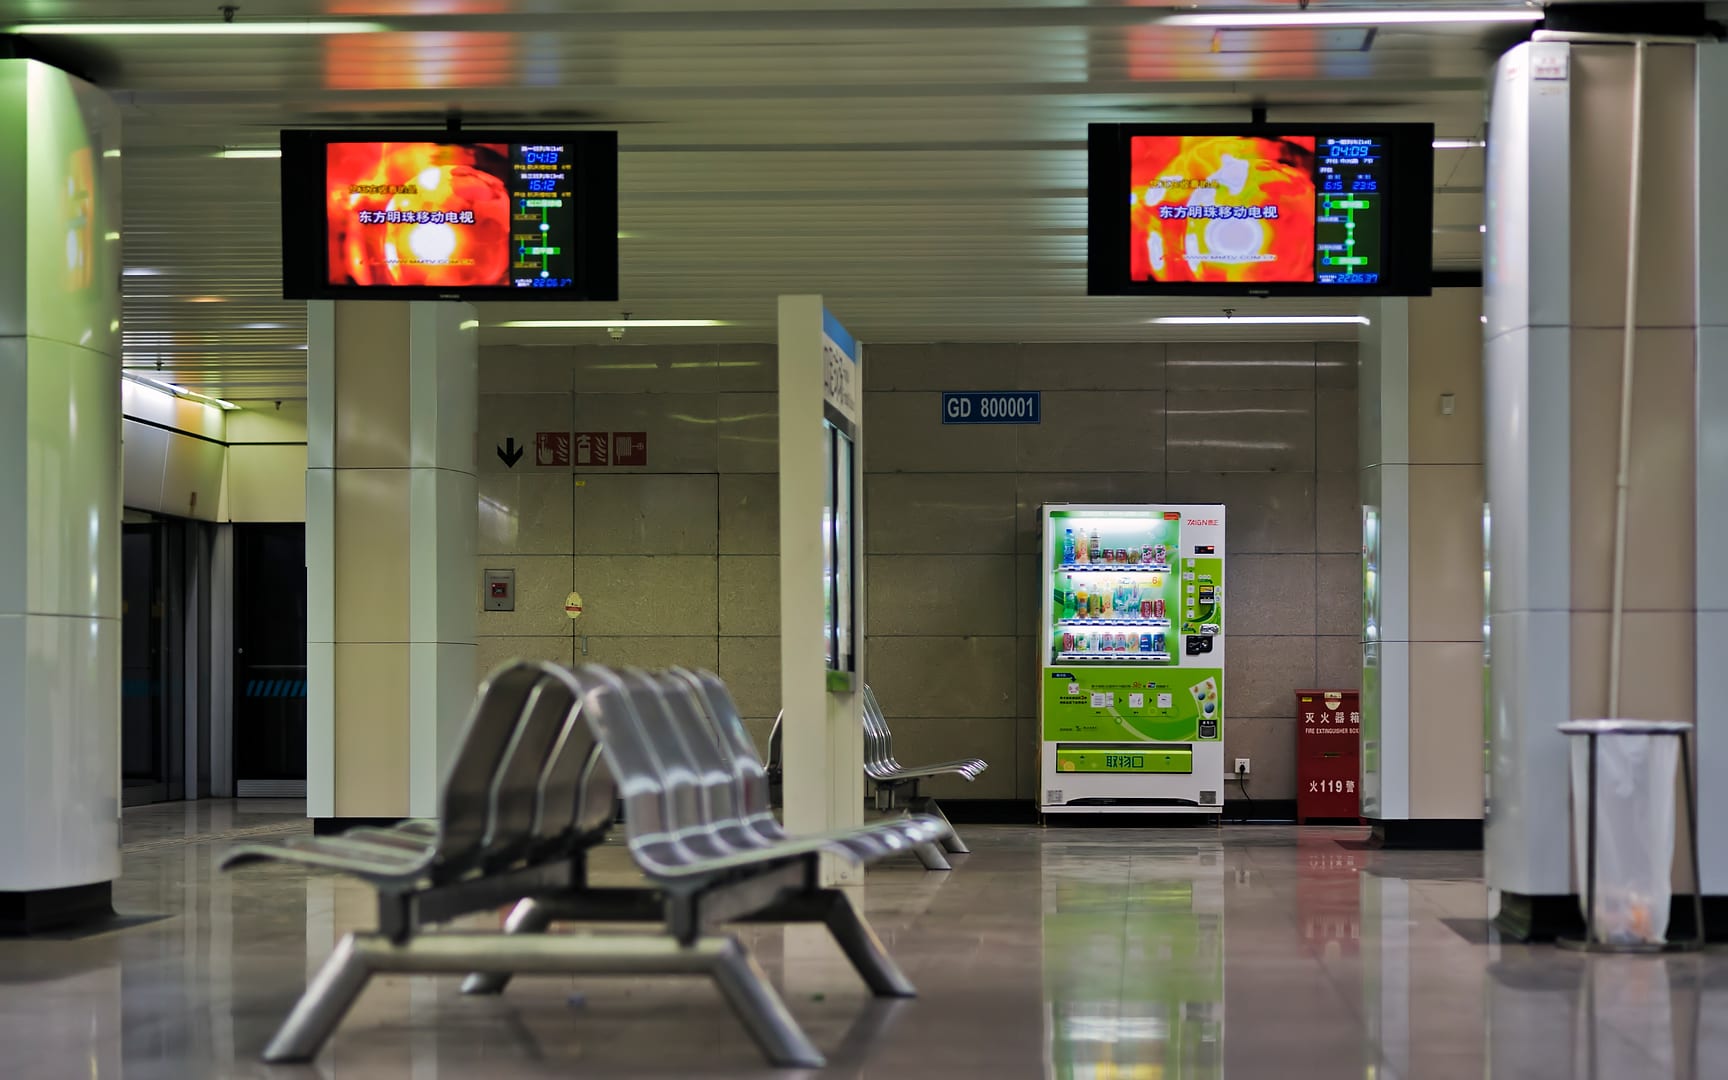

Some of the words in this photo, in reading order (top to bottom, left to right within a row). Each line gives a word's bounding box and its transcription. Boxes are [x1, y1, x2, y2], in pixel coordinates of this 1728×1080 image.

[527, 152, 558, 163] 04:13
[1331, 146, 1368, 157] 04:09
[529, 180, 555, 191] 16:12
[359, 210, 475, 224] 东方明珠移动电视
[1159, 205, 1278, 219] 东方明珠移动电视
[947, 398, 971, 417] GD
[981, 397, 1033, 417] 800001
[1305, 712, 1359, 723] 灭火器箱
[1106, 755, 1143, 768] 取物口
[1309, 780, 1355, 792] 火119警
